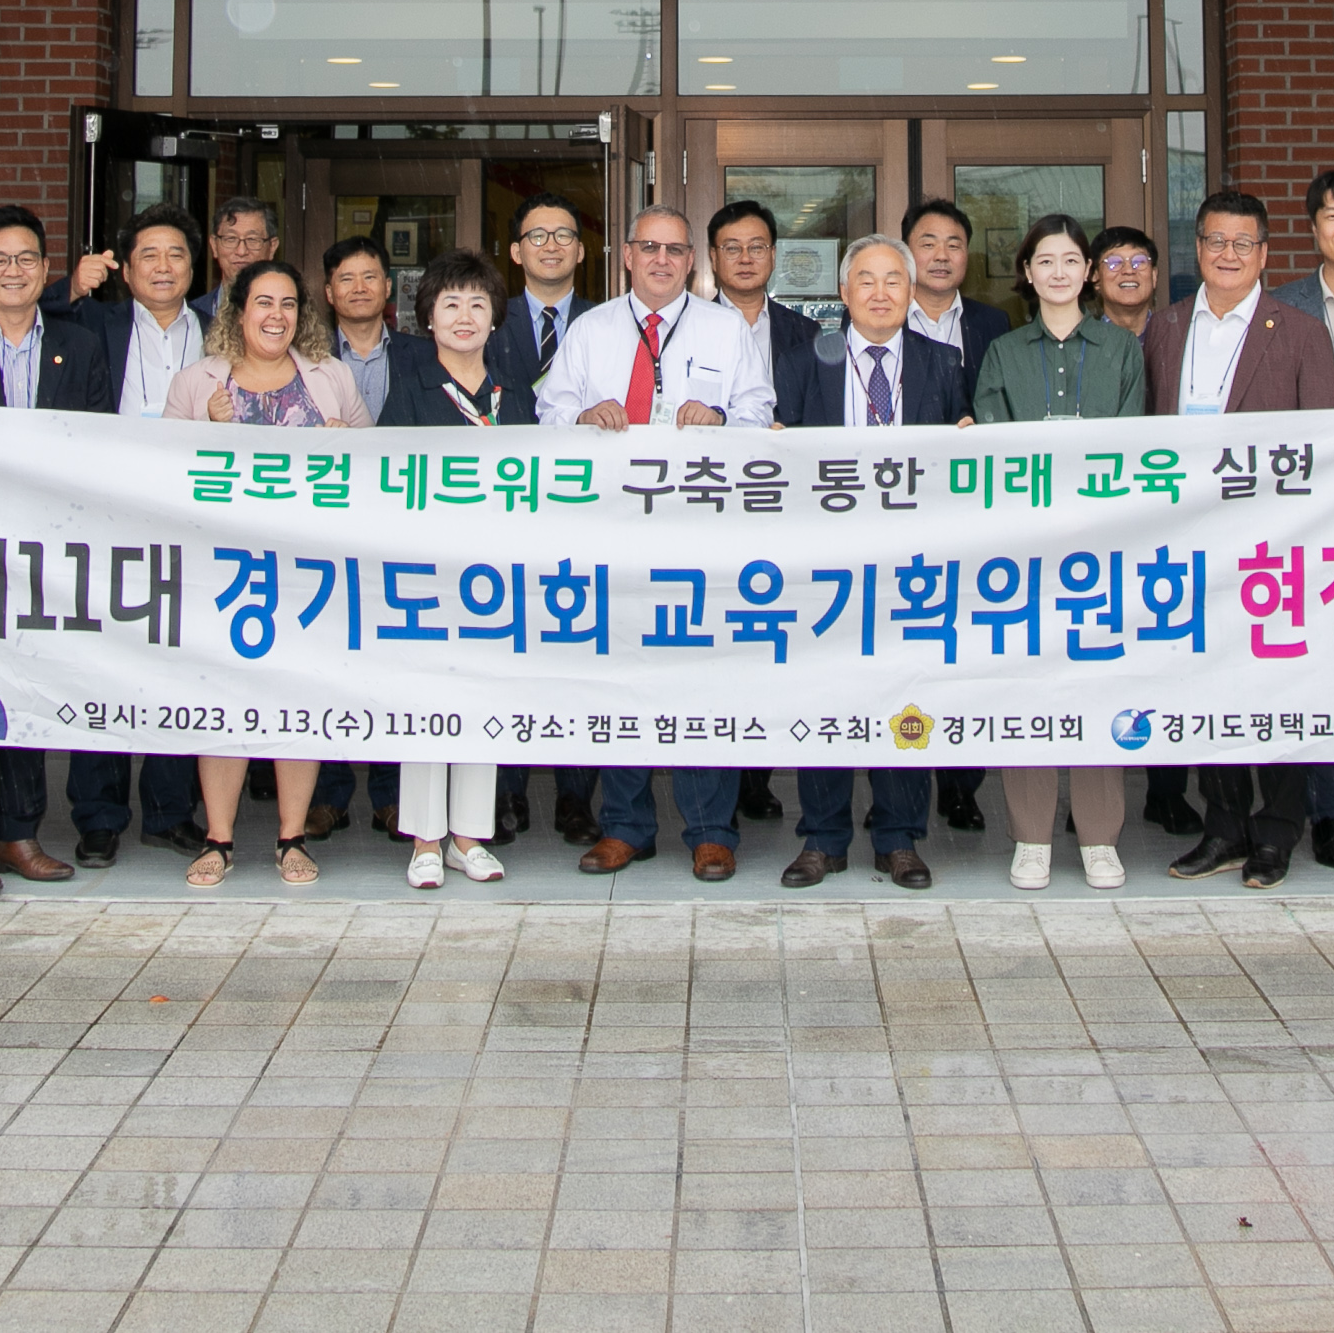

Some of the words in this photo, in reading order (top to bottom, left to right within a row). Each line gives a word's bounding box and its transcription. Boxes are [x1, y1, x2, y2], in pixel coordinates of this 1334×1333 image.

[188, 450, 350, 507] 글로컬
[381, 454, 599, 512] 네트워크
[623, 457, 789, 514] 구축을
[812, 457, 924, 512] 통한
[950, 454, 1052, 509] 미래
[1077, 449, 1186, 504] 교육
[1213, 444, 1313, 500] 실현
[214, 547, 609, 659] 경기도의회
[642, 545, 1206, 664] 교육기획위원회
[85, 702, 146, 730] 일시:
[158, 706, 232, 733] 2023.
[245, 709, 266, 734] 9.
[279, 709, 373, 741] 13.(수)
[386, 713, 461, 736] 11:00
[512, 715, 574, 742] 장소:
[588, 716, 640, 743] 캠프
[655, 715, 766, 743] 험프리스
[818, 716, 881, 743] 주최:
[943, 715, 1082, 744] 경기도의회
[900, 722, 924, 735] 의회
